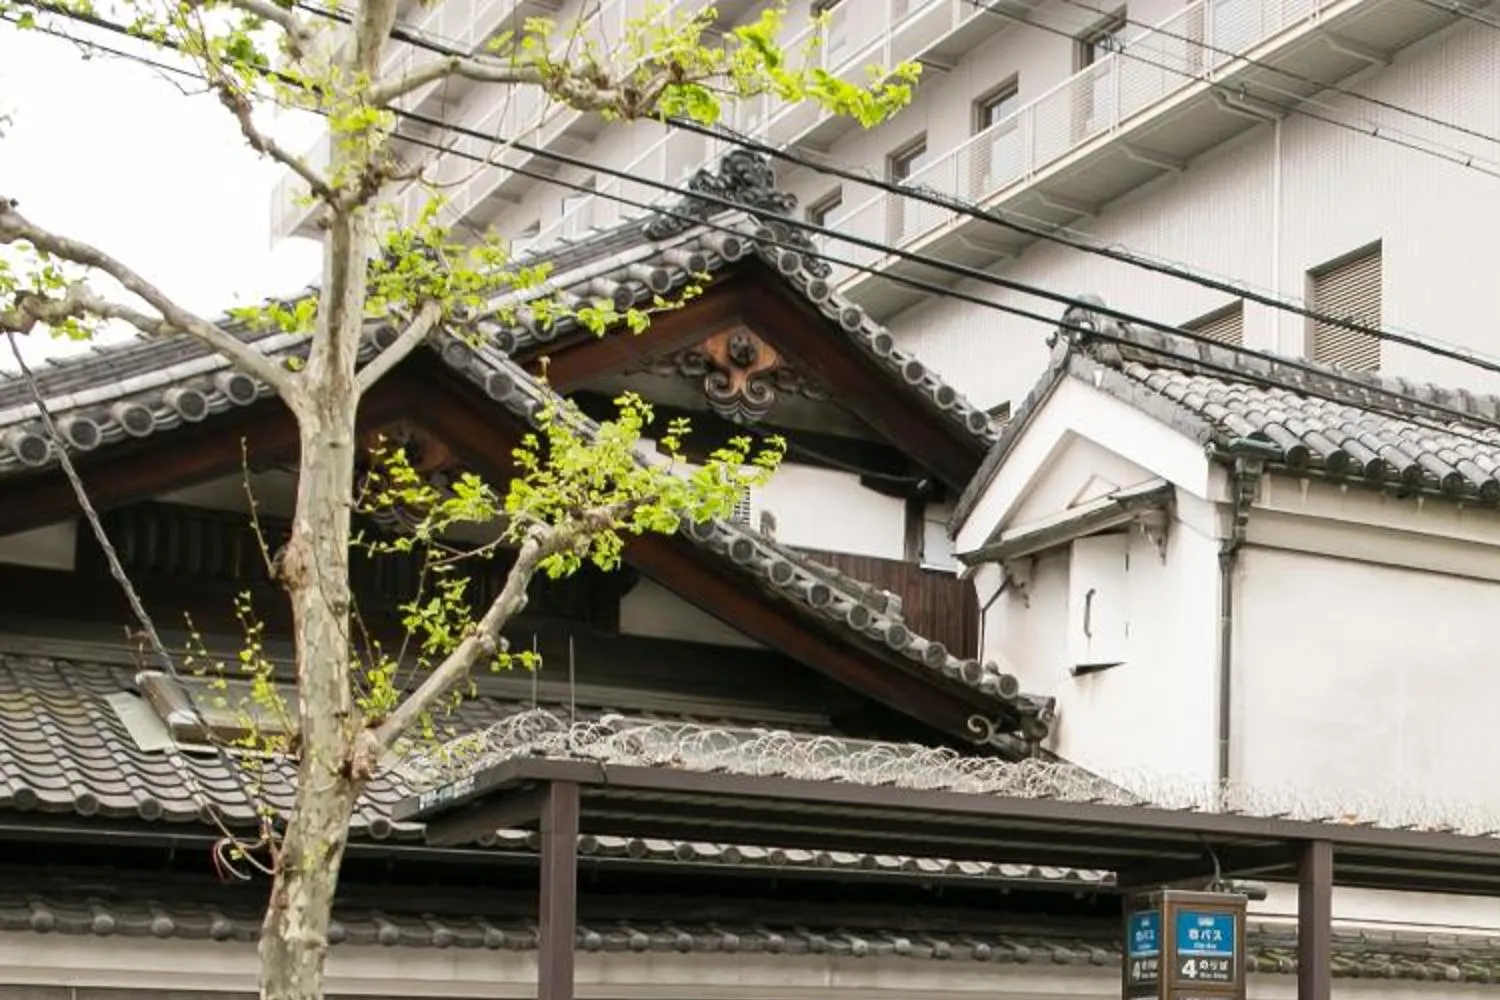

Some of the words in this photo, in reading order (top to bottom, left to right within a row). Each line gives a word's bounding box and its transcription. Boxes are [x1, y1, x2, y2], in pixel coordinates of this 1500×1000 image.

[1132, 961, 1141, 979] 4
[1181, 959, 1197, 978] 4
[1200, 959, 1228, 971] のりば
